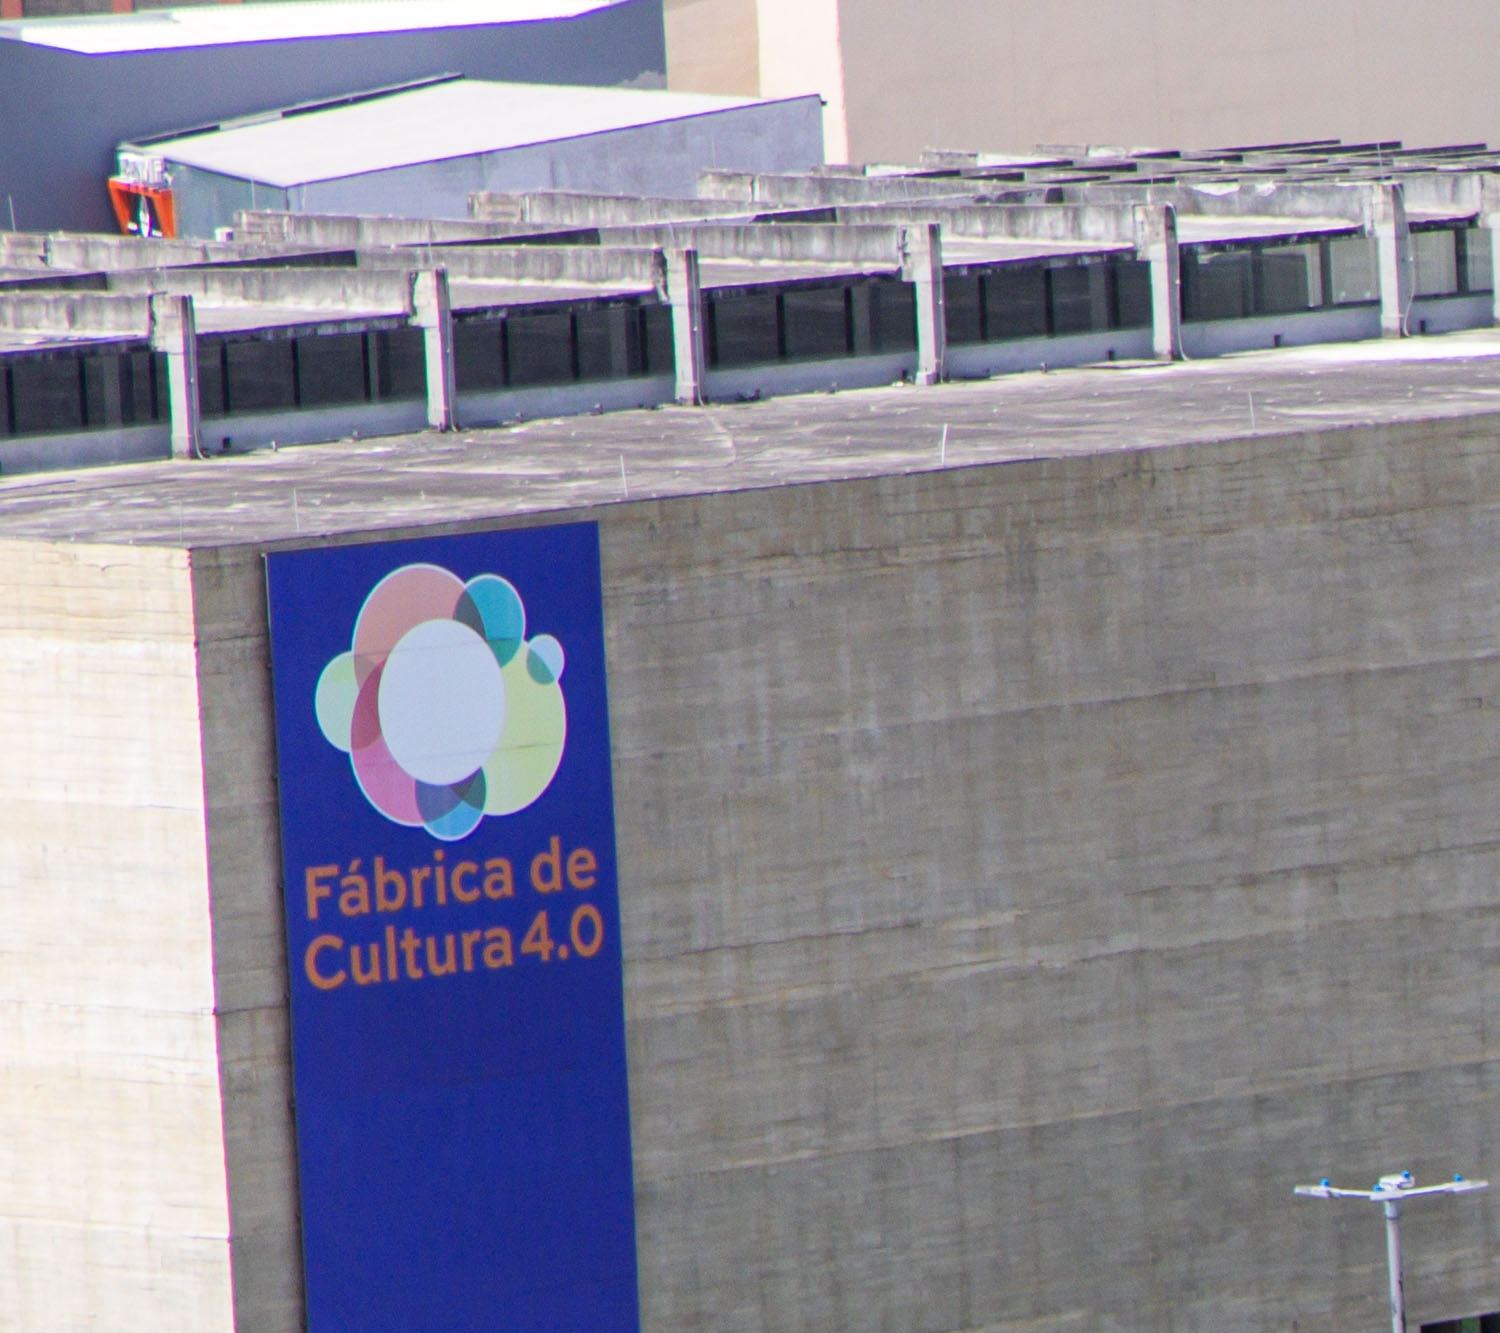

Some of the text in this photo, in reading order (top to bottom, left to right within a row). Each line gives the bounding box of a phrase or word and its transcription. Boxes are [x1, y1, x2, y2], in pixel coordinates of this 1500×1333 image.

[304, 835, 597, 920] Fábrica de
[304, 904, 604, 990] Cultura 4.0
